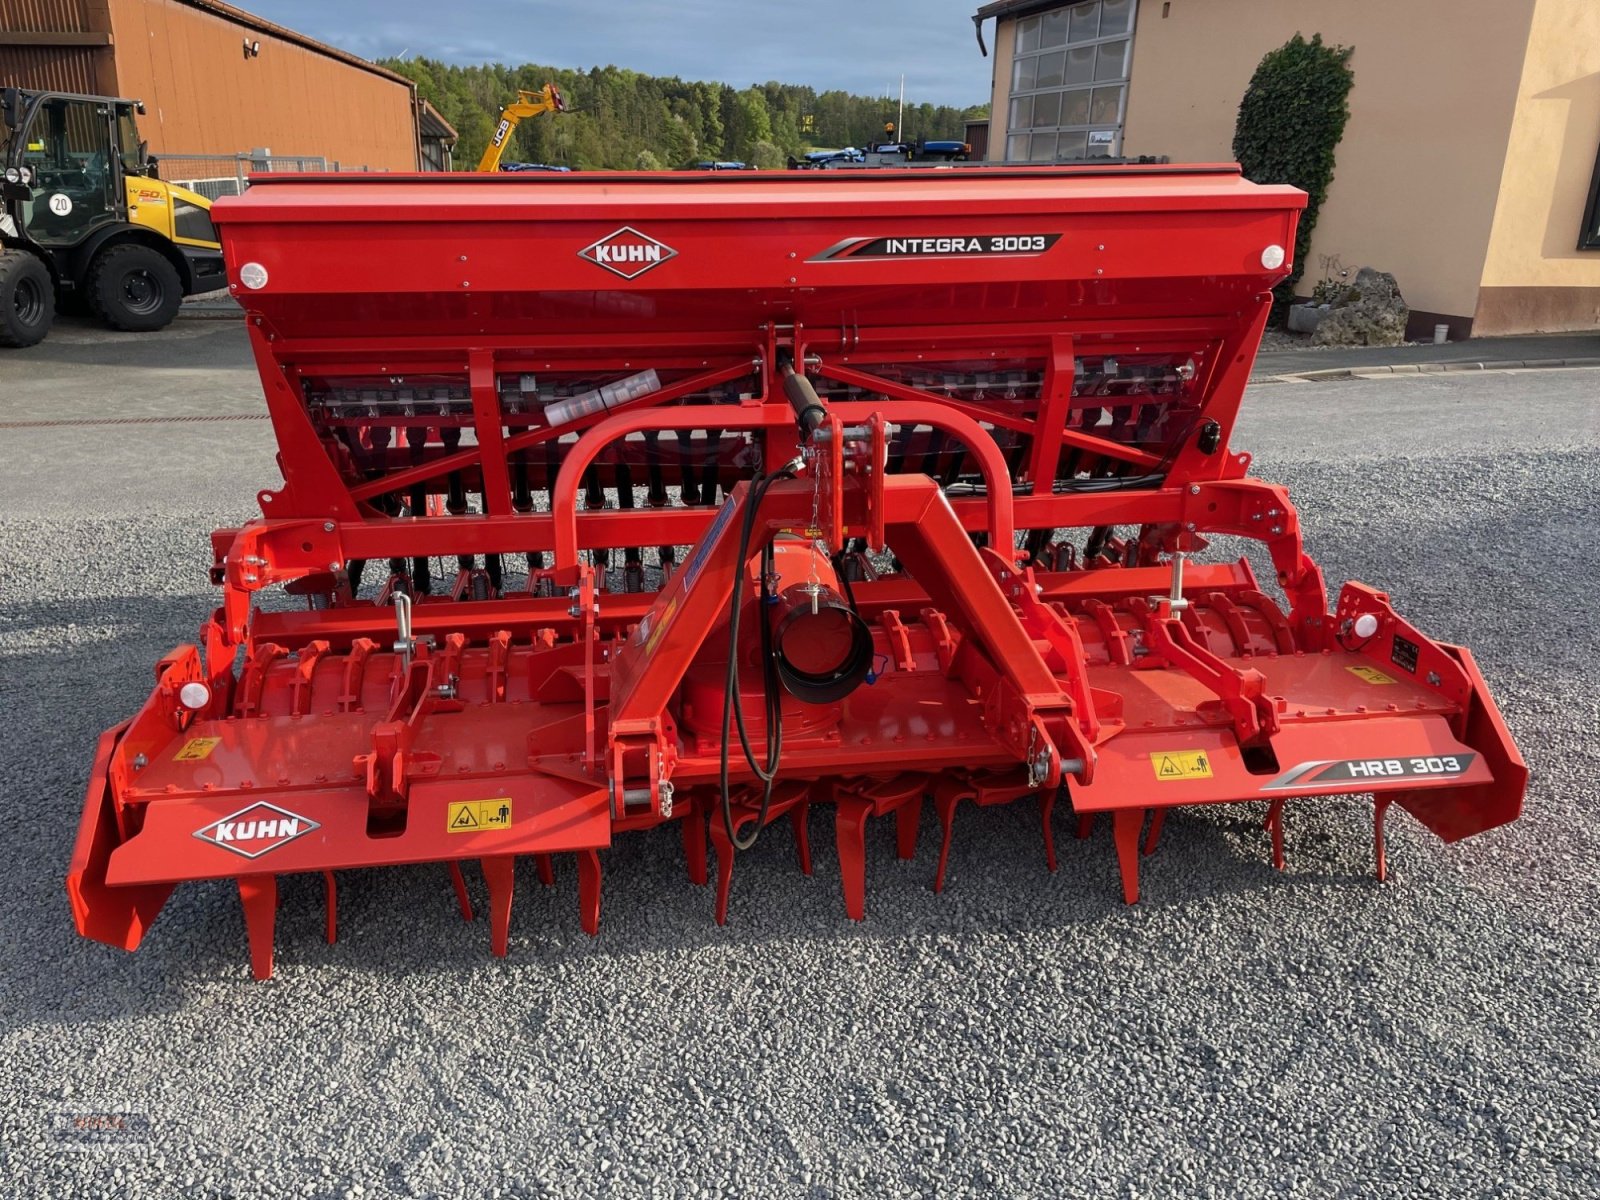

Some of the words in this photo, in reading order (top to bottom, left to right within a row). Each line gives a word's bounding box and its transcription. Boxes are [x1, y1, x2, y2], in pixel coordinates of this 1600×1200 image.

[493, 120, 509, 147] JCB
[55, 198, 67, 211] 20
[595, 244, 661, 262] KUHN
[886, 238, 983, 253] INTEGRA
[991, 236, 1045, 251] 3003
[1347, 759, 1404, 777] HRB
[1410, 757, 1461, 774] 303
[215, 818, 299, 842] KUHN
